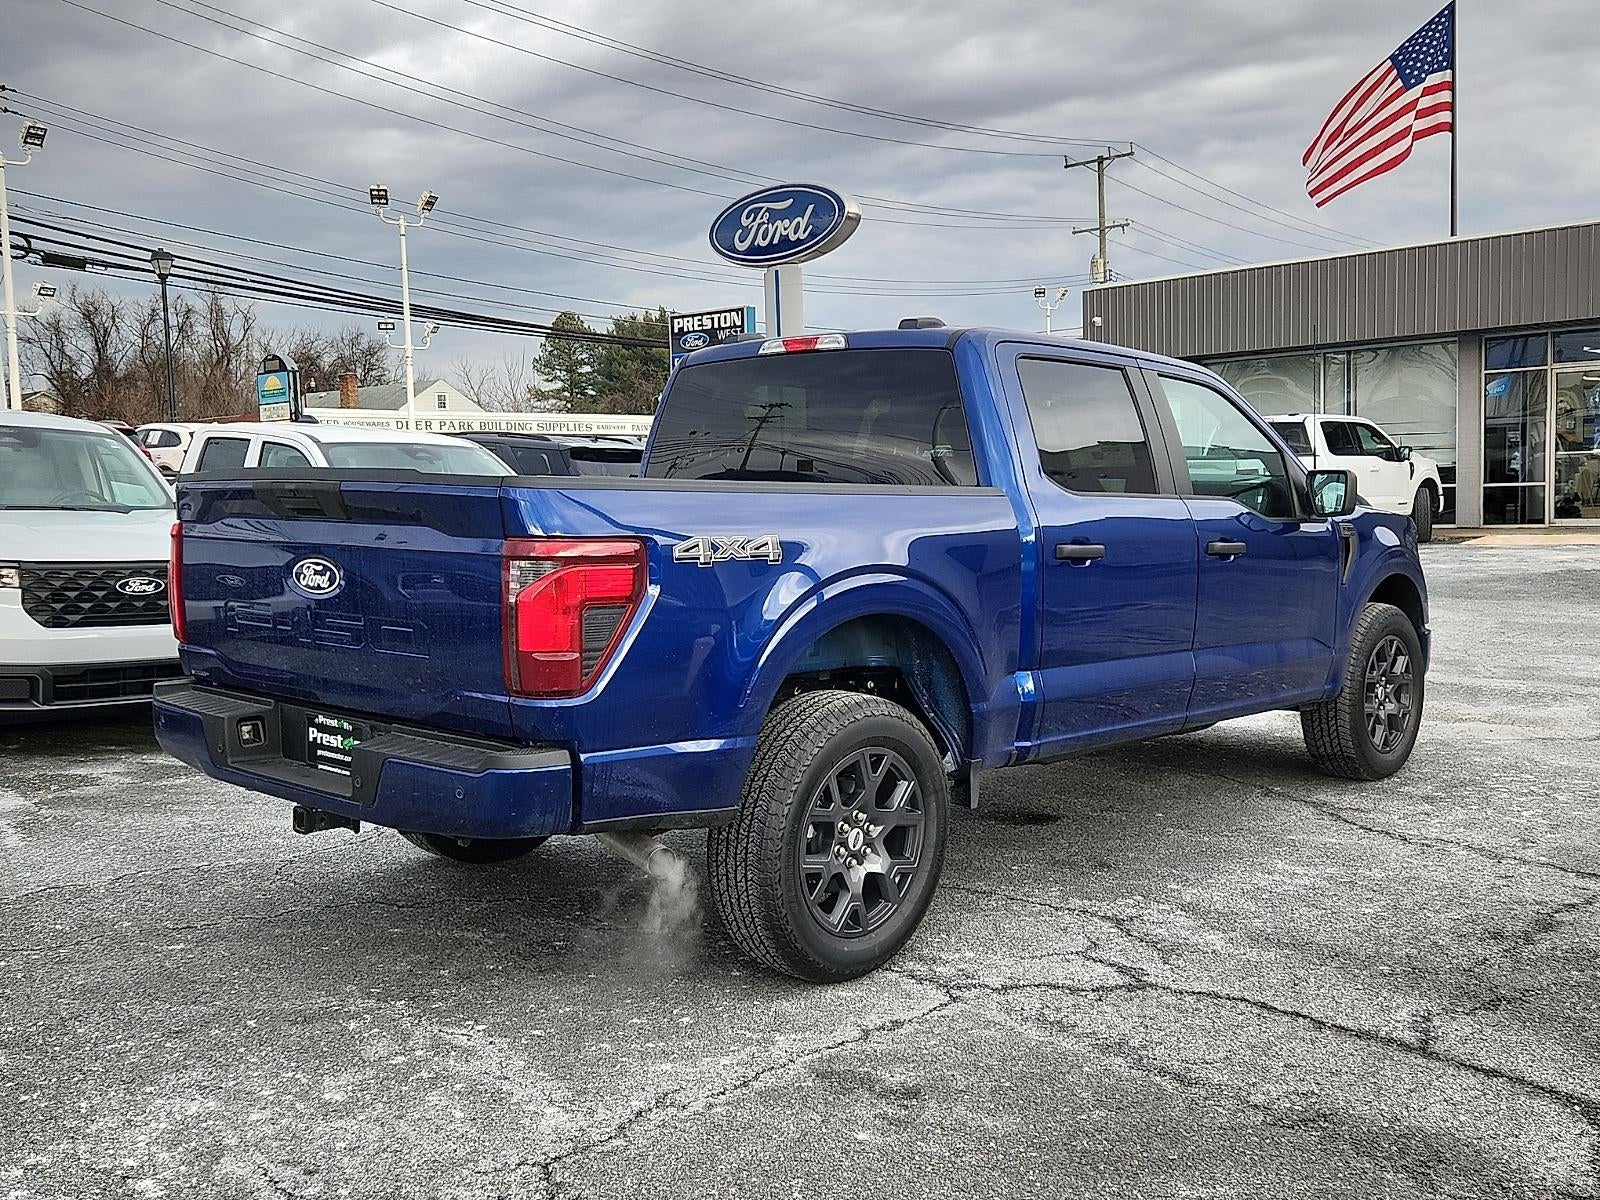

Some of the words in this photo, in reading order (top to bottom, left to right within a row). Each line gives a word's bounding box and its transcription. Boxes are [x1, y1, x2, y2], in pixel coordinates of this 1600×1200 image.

[733, 198, 816, 251] Ford
[674, 311, 742, 333] PRESTON
[717, 327, 742, 340] WEST
[439, 421, 475, 431] PARK
[479, 421, 533, 432] BUILDING
[537, 422, 593, 432] SUPPLIES
[631, 424, 652, 432] PAIN
[300, 563, 331, 588] Ford
[125, 580, 156, 592] Ford
